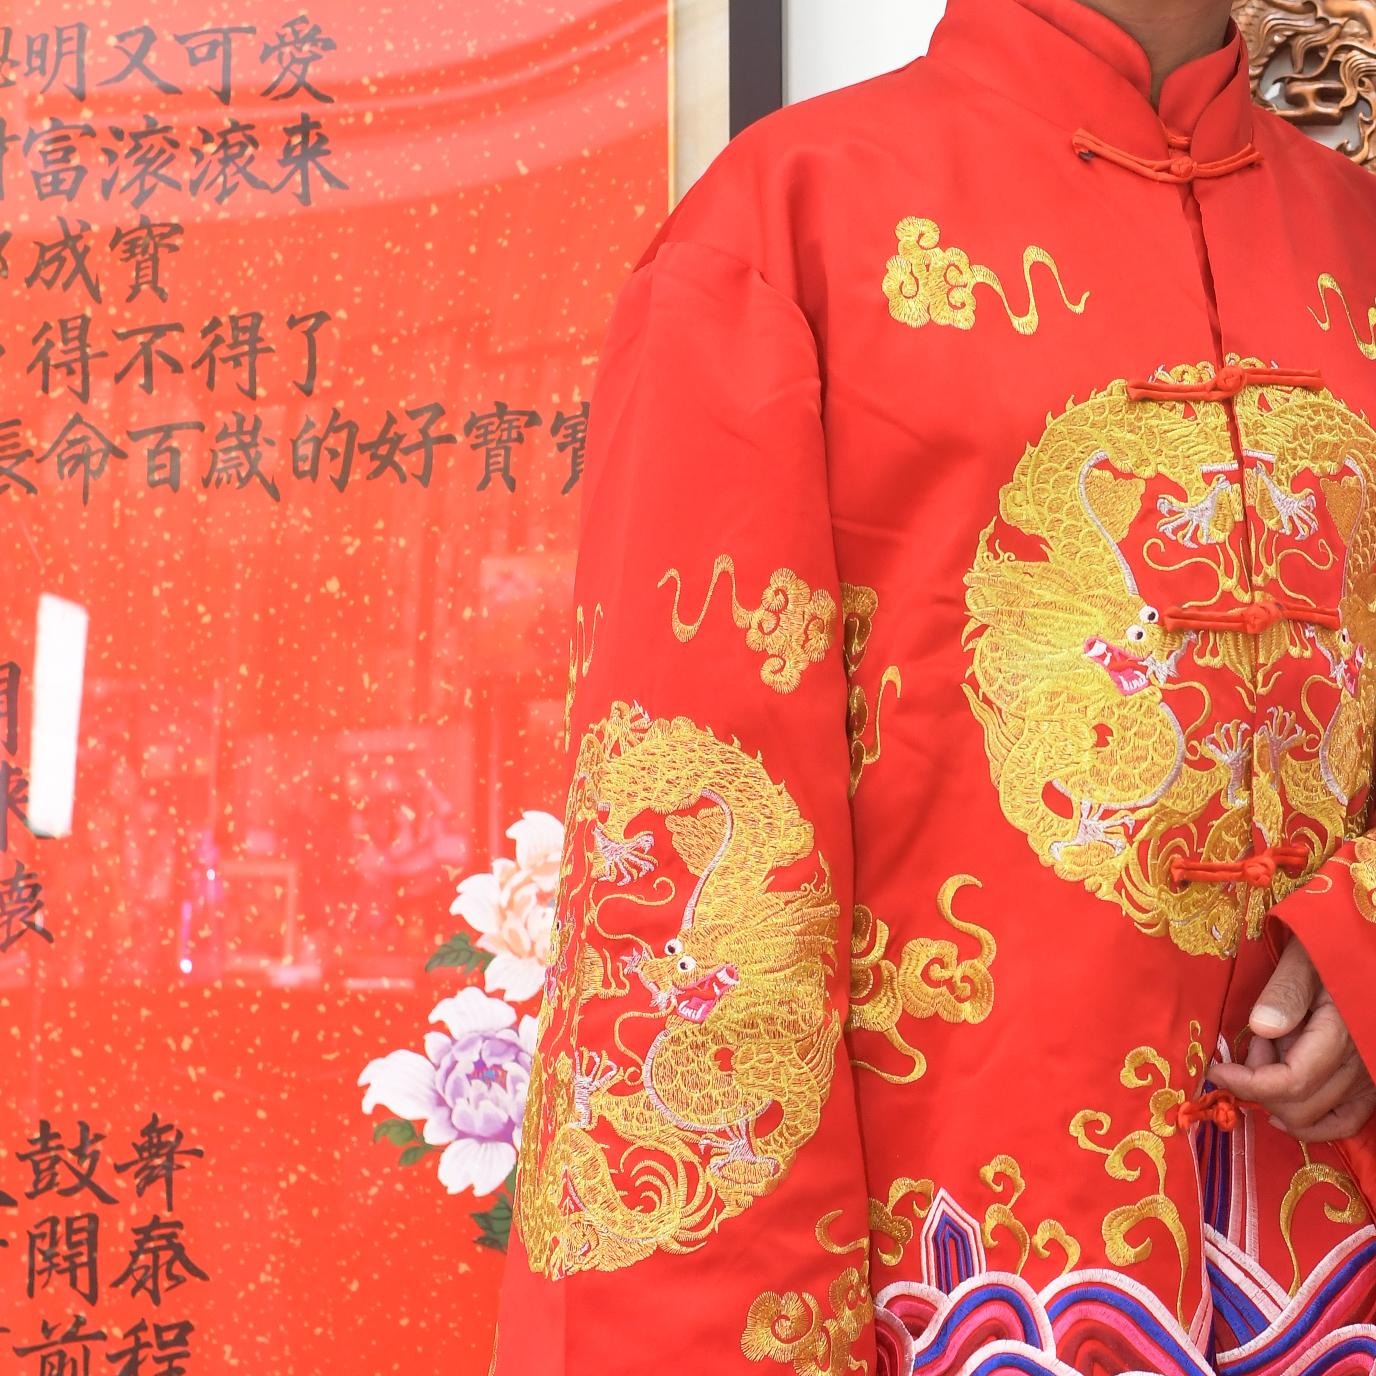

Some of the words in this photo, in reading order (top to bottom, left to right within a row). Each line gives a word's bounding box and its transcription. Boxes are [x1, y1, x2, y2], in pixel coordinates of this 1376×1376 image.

[0, 15, 337, 105] 明又可愛
[0, 113, 348, 208] 富滾滾來
[0, 214, 184, 304] 成寶
[0, 311, 331, 403] 得不得了
[0, 1112, 204, 1212] 鼓舞
[0, 1213, 209, 1306] 開泰
